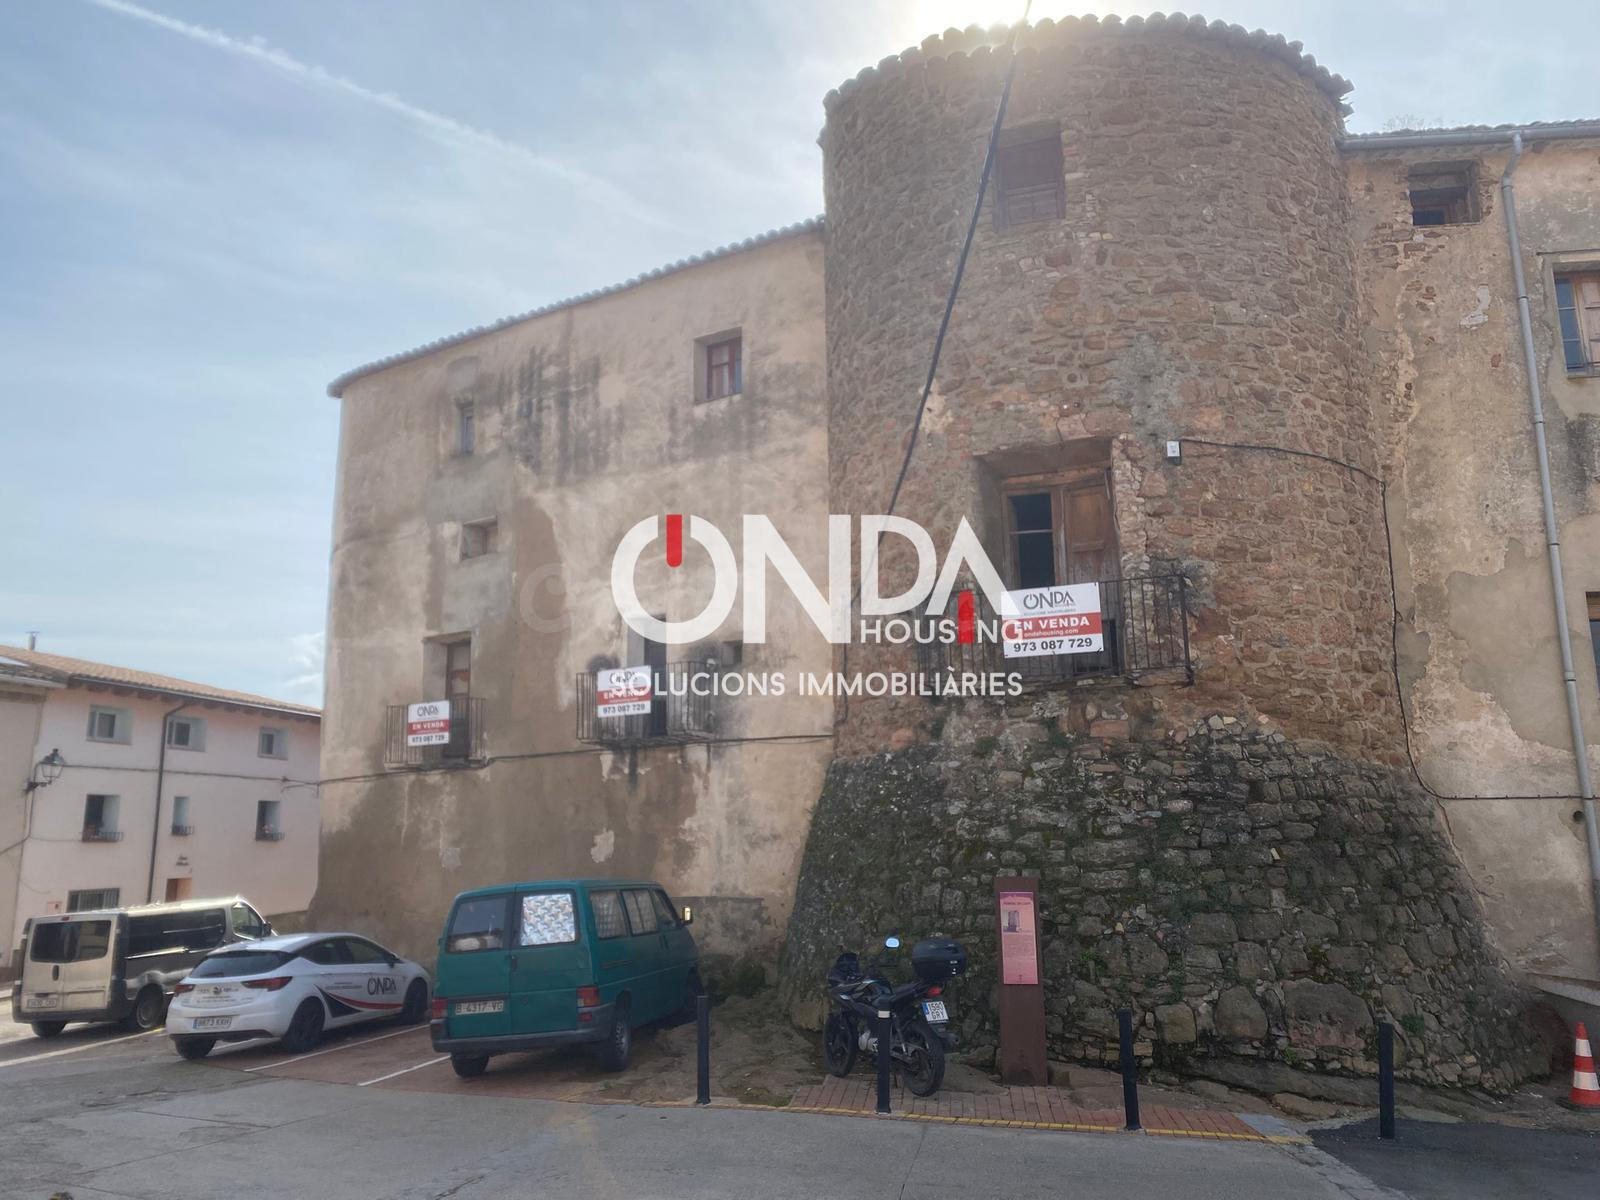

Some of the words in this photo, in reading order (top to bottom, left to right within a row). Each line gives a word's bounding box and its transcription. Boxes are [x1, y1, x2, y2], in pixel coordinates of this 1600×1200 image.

[1023, 591, 1074, 610] ONDA
[1014, 619, 1033, 631] EN
[1038, 615, 1090, 629] VENDA
[1014, 642, 1037, 652] 973
[1041, 639, 1064, 650] 087
[1069, 637, 1093, 648] 729
[367, 976, 397, 996] ONDA
